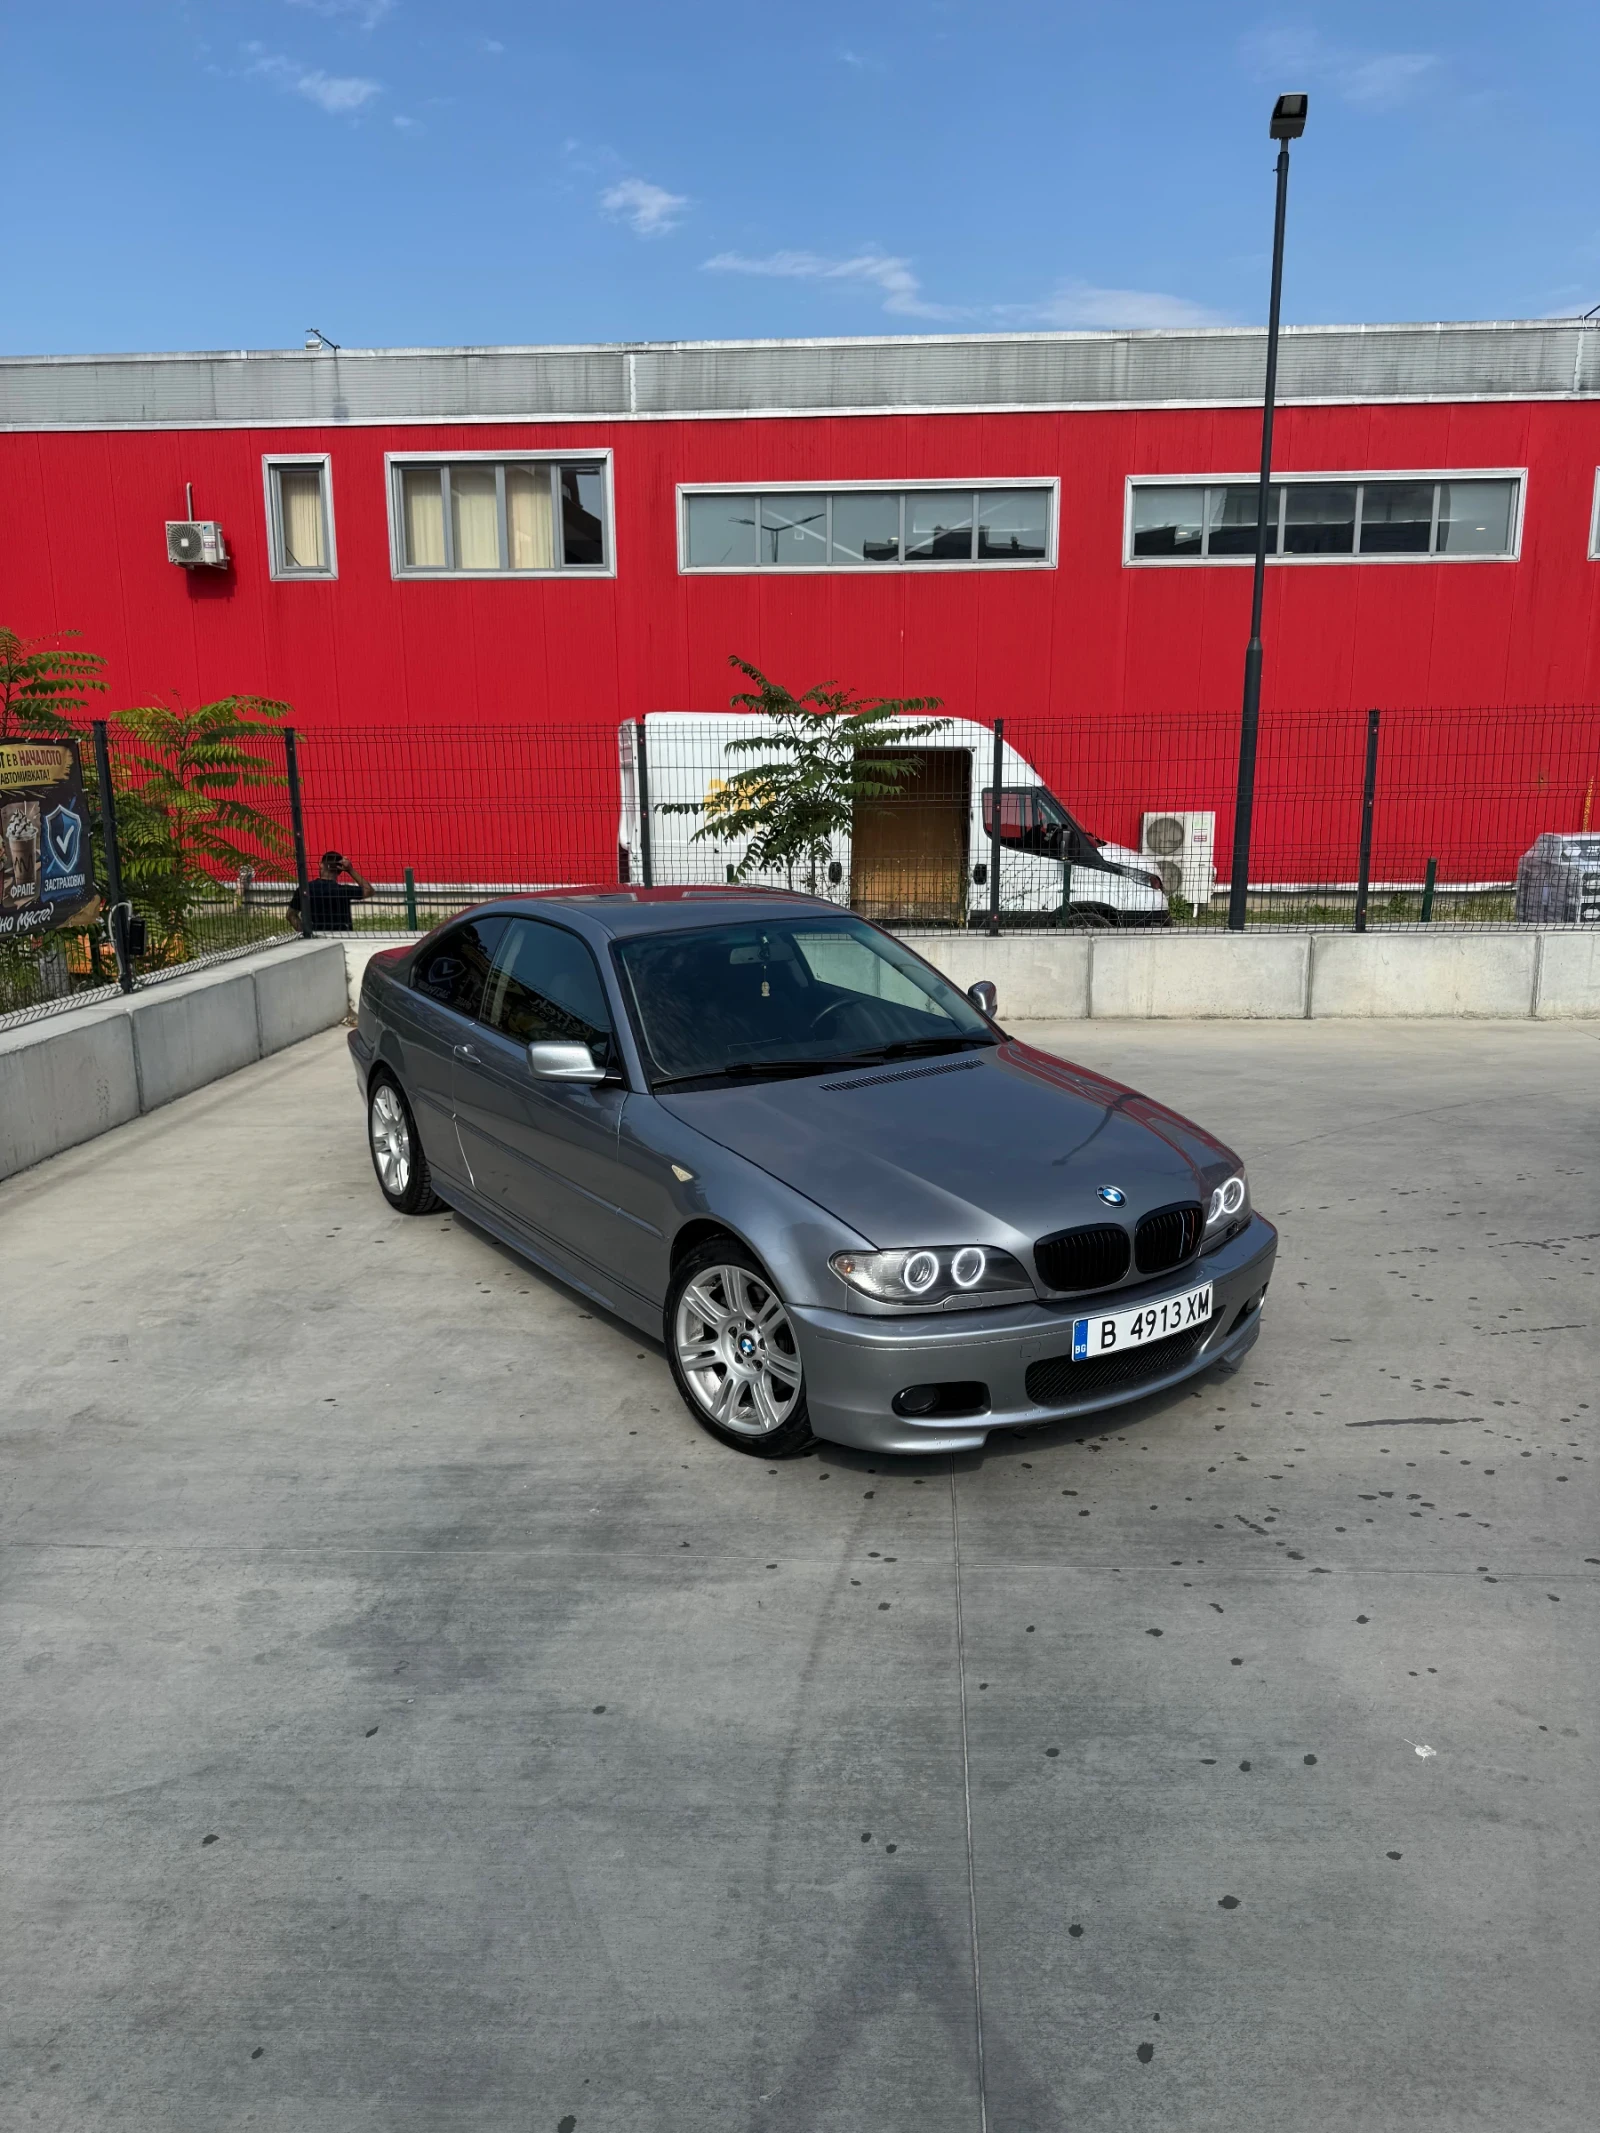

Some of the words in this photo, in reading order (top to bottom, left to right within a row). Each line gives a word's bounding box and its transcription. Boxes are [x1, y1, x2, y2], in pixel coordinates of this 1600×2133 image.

[6, 753, 11, 767] Е
[12, 753, 18, 766] В
[18, 749, 62, 767] НАЧАЛОТО
[0, 769, 51, 785] АВТОМИВКАТА!
[10, 882, 36, 898] ФРАПЕ
[44, 873, 86, 892] ЗАСТРАХОВКИ
[0, 916, 14, 932] НО
[1101, 1320, 1117, 1349] B
[1130, 1301, 1182, 1340] 4913
[1186, 1288, 1210, 1324] XM
[1075, 1343, 1087, 1354] BG
